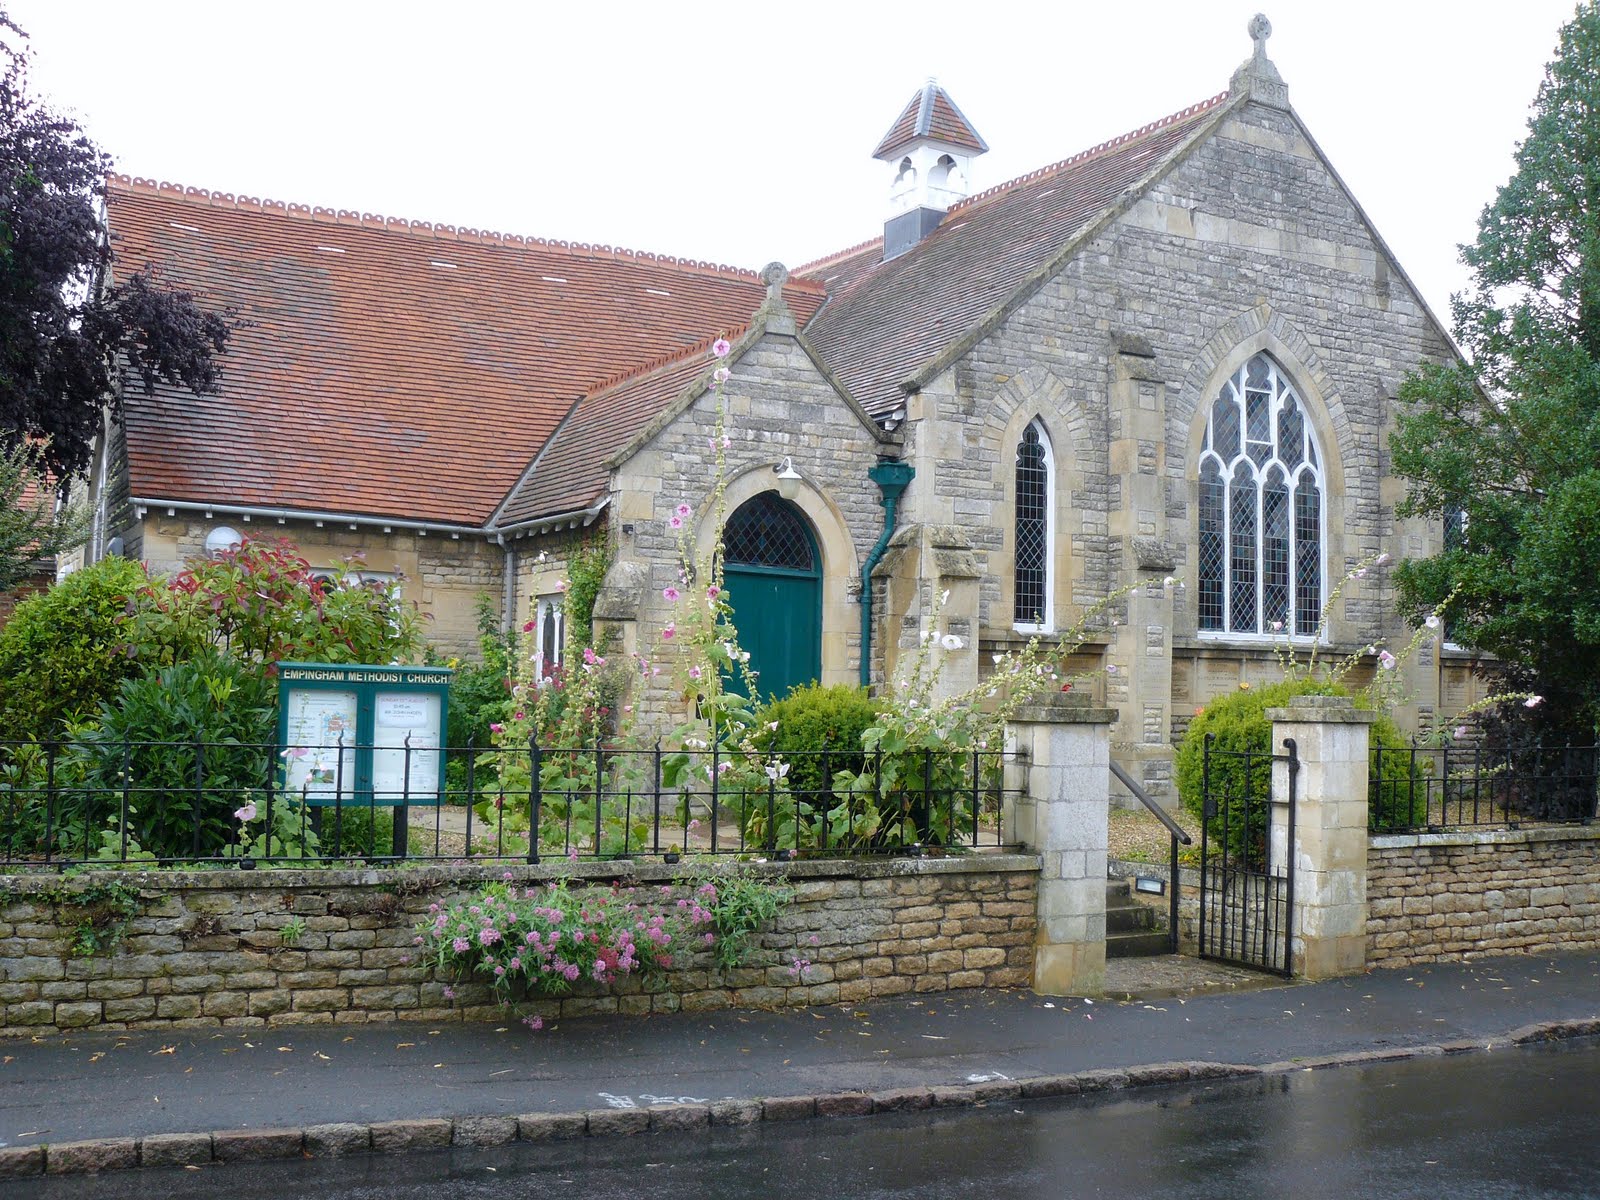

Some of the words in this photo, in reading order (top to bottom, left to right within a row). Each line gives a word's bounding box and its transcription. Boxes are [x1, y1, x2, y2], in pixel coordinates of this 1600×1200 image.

[1253, 78, 1284, 100] 1899
[283, 669, 345, 681] EMPINGHAM
[347, 671, 403, 683] METHODIST
[407, 673, 448, 685] CHURCH
